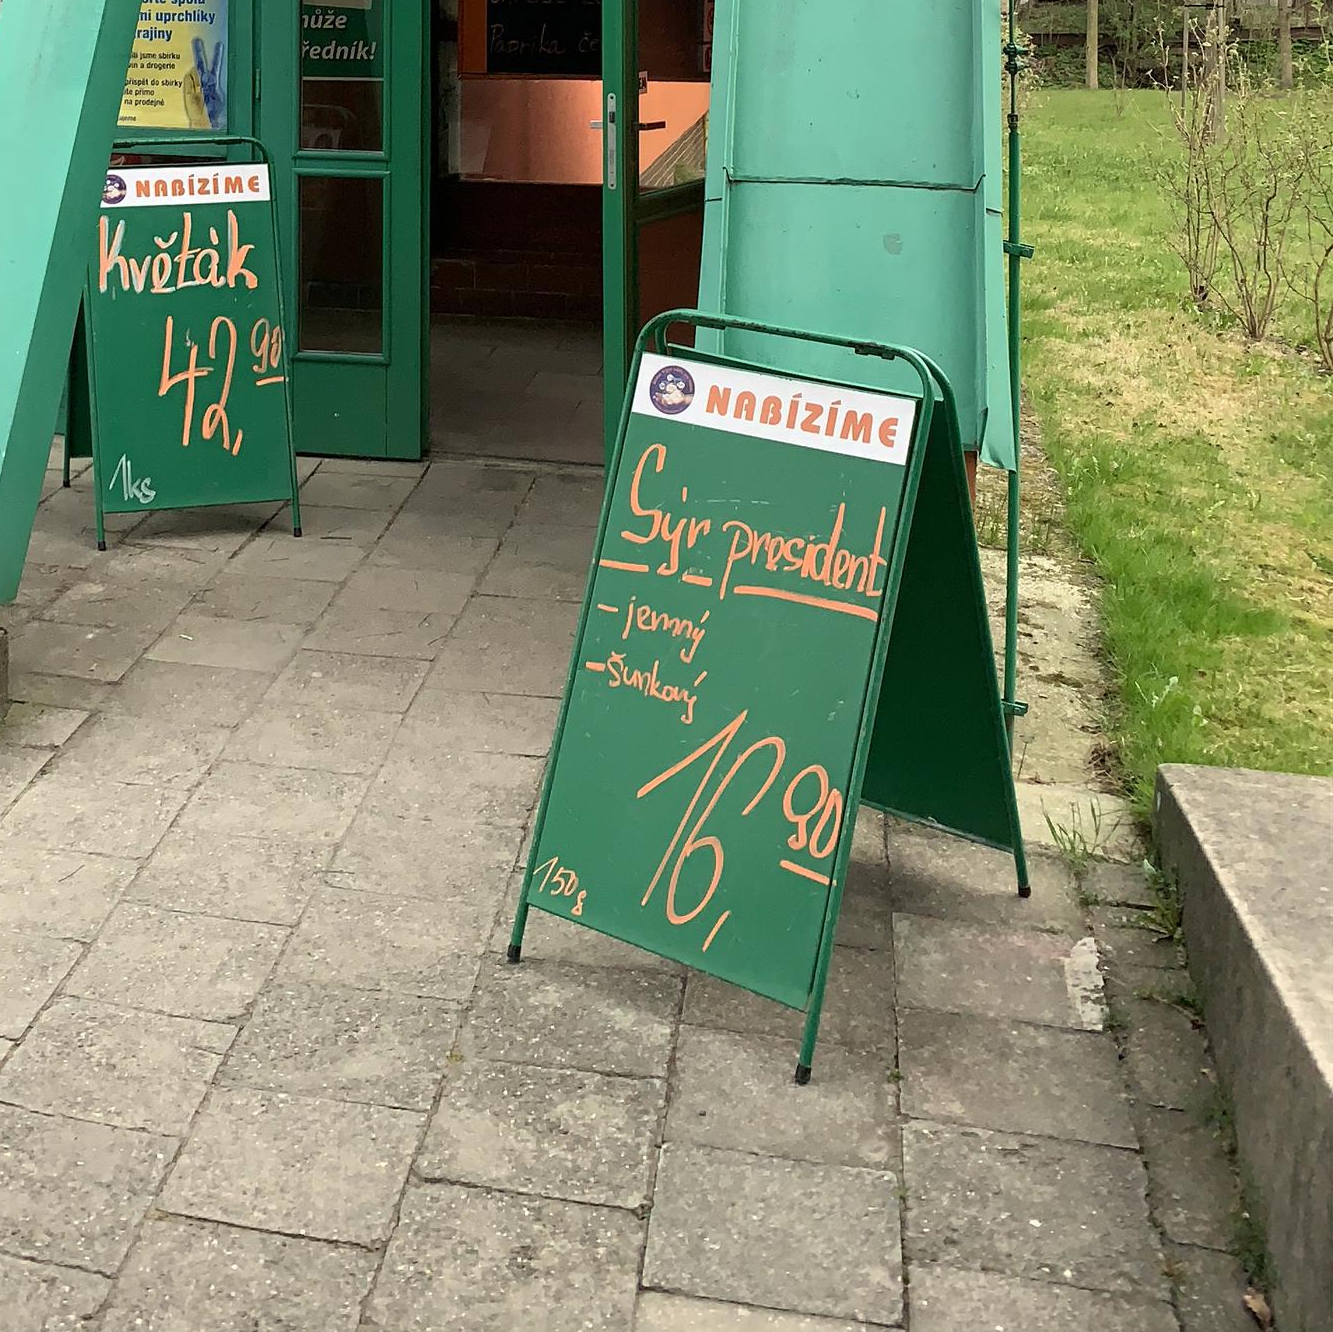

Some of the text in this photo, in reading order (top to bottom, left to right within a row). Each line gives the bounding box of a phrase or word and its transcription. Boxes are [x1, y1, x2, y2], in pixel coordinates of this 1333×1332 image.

[156, 9, 216, 24] uprchlíky
[302, 8, 348, 29] ůže
[137, 27, 173, 42] rajiny
[302, 40, 377, 60] ředník!
[151, 77, 159, 86] do
[135, 173, 260, 198] NABÍZÍME
[99, 209, 258, 294] Květák
[705, 385, 900, 448] NABÍZÍME
